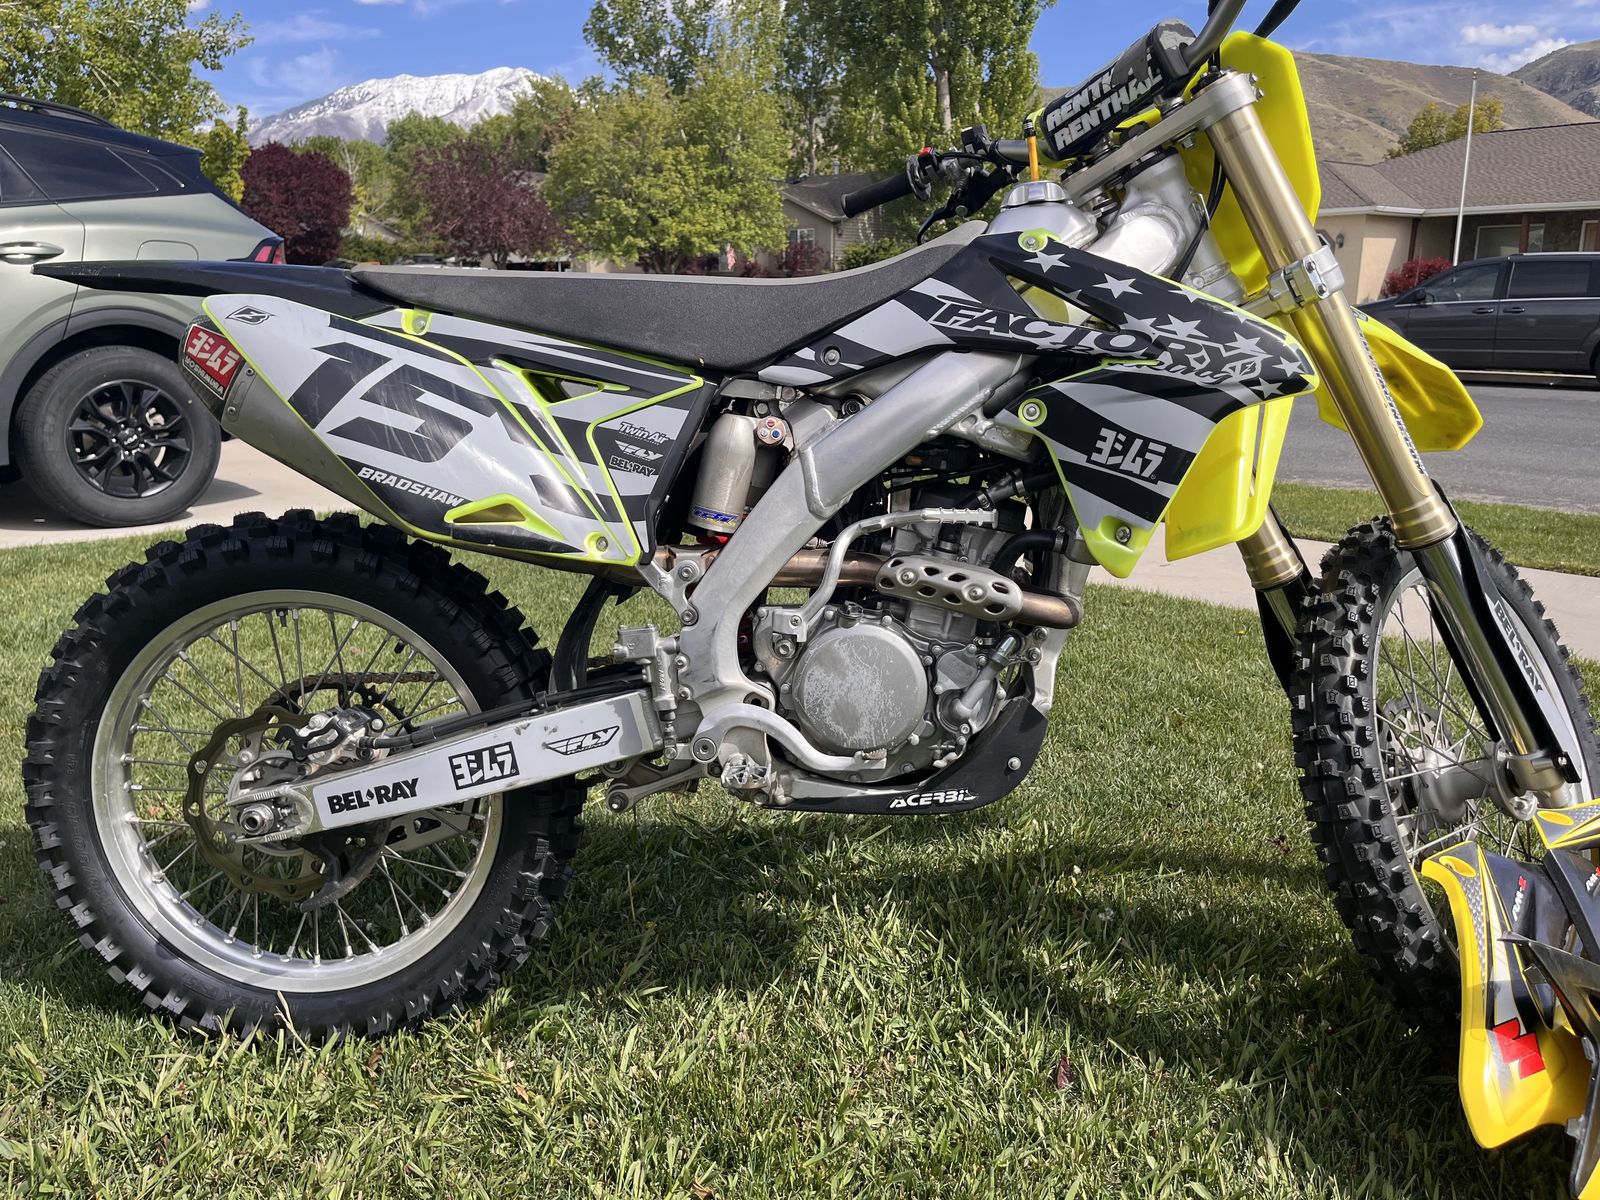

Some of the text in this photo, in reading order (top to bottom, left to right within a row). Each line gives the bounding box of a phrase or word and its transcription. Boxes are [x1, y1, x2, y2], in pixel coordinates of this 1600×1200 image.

[929, 302, 1262, 368] FACTORY
[619, 421, 650, 440] Twin
[647, 431, 671, 445] Air
[618, 441, 664, 461] FLY
[357, 466, 464, 508] BRADSHAW
[560, 727, 620, 753] FLY
